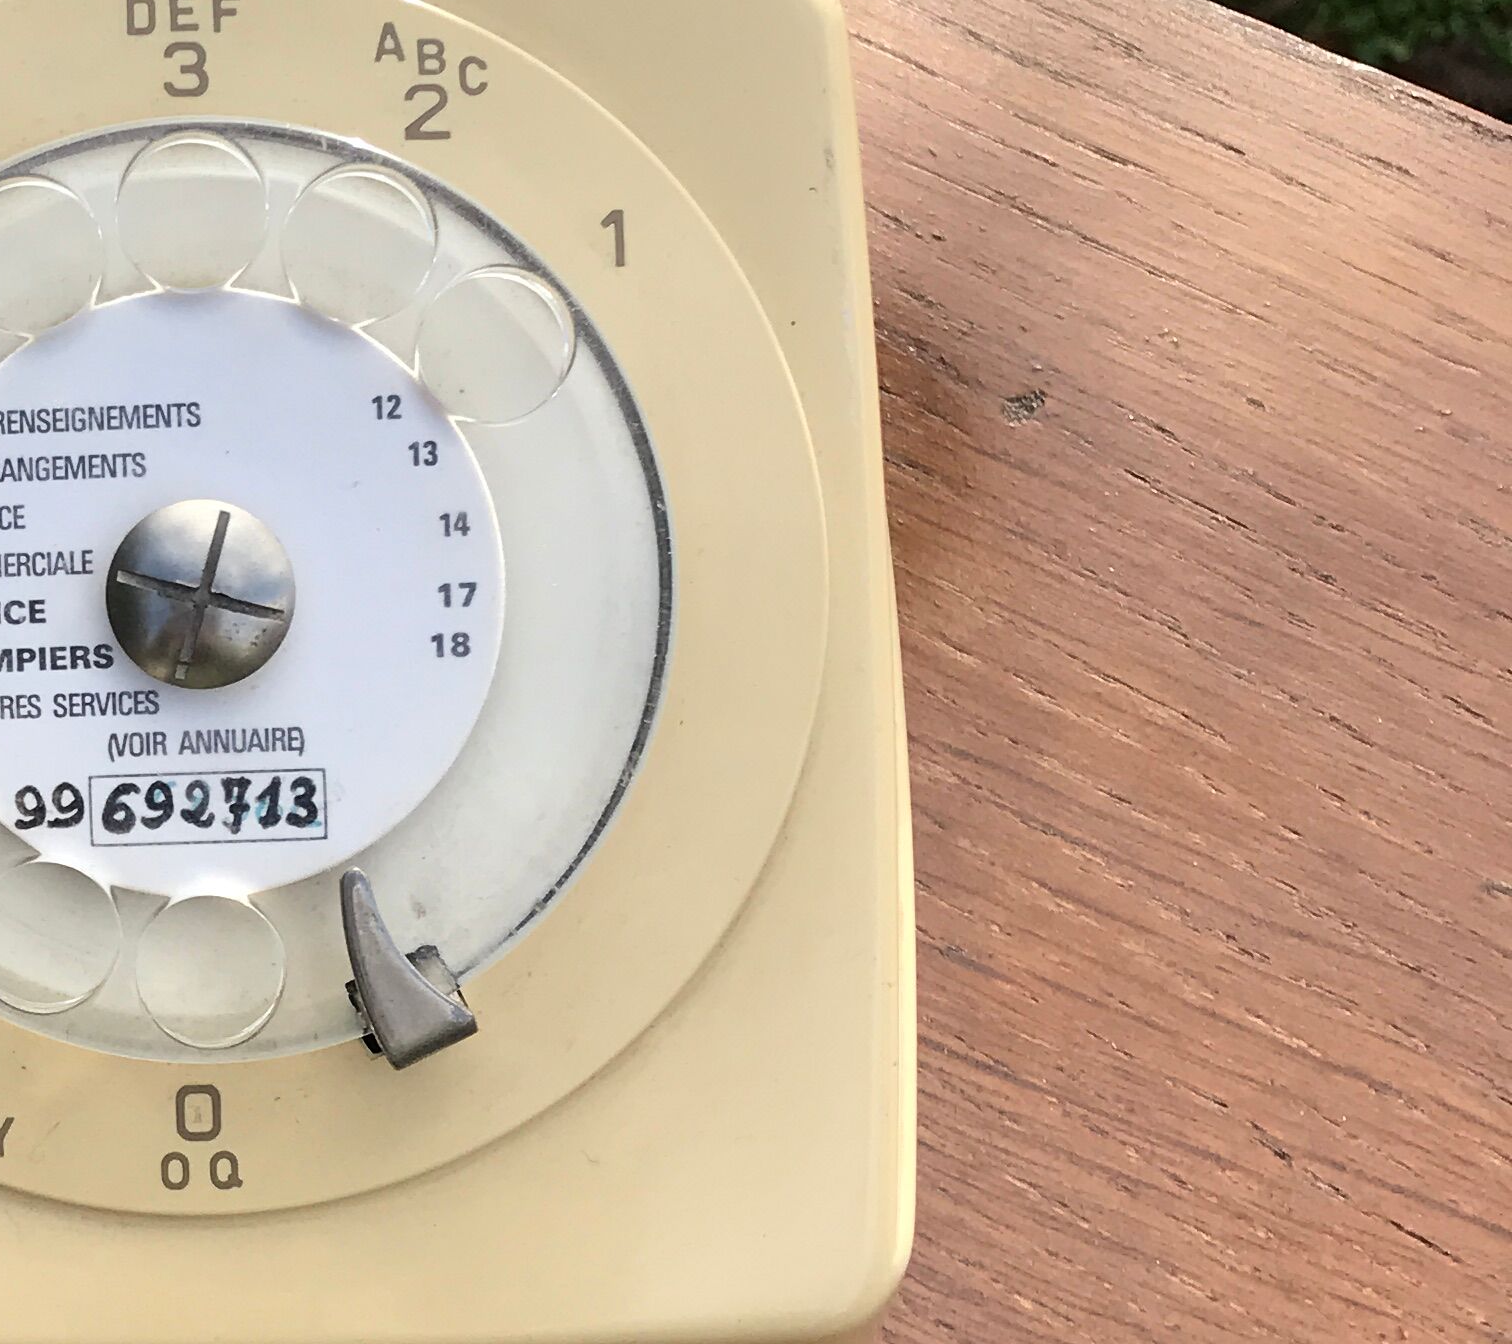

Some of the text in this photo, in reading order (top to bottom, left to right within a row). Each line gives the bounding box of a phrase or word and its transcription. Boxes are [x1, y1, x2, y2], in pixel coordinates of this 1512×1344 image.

[163, 42, 210, 97] 3
[404, 84, 452, 140] 2
[600, 209, 626, 267] 1
[372, 396, 402, 420] 12
[408, 441, 438, 466] 13
[439, 513, 470, 537] 14
[438, 583, 478, 608] 17
[431, 633, 470, 658] 18
[53, 691, 160, 717] SERVICES
[107, 727, 305, 762] (VOIR ANNUAIRE)
[14, 782, 85, 830] 99
